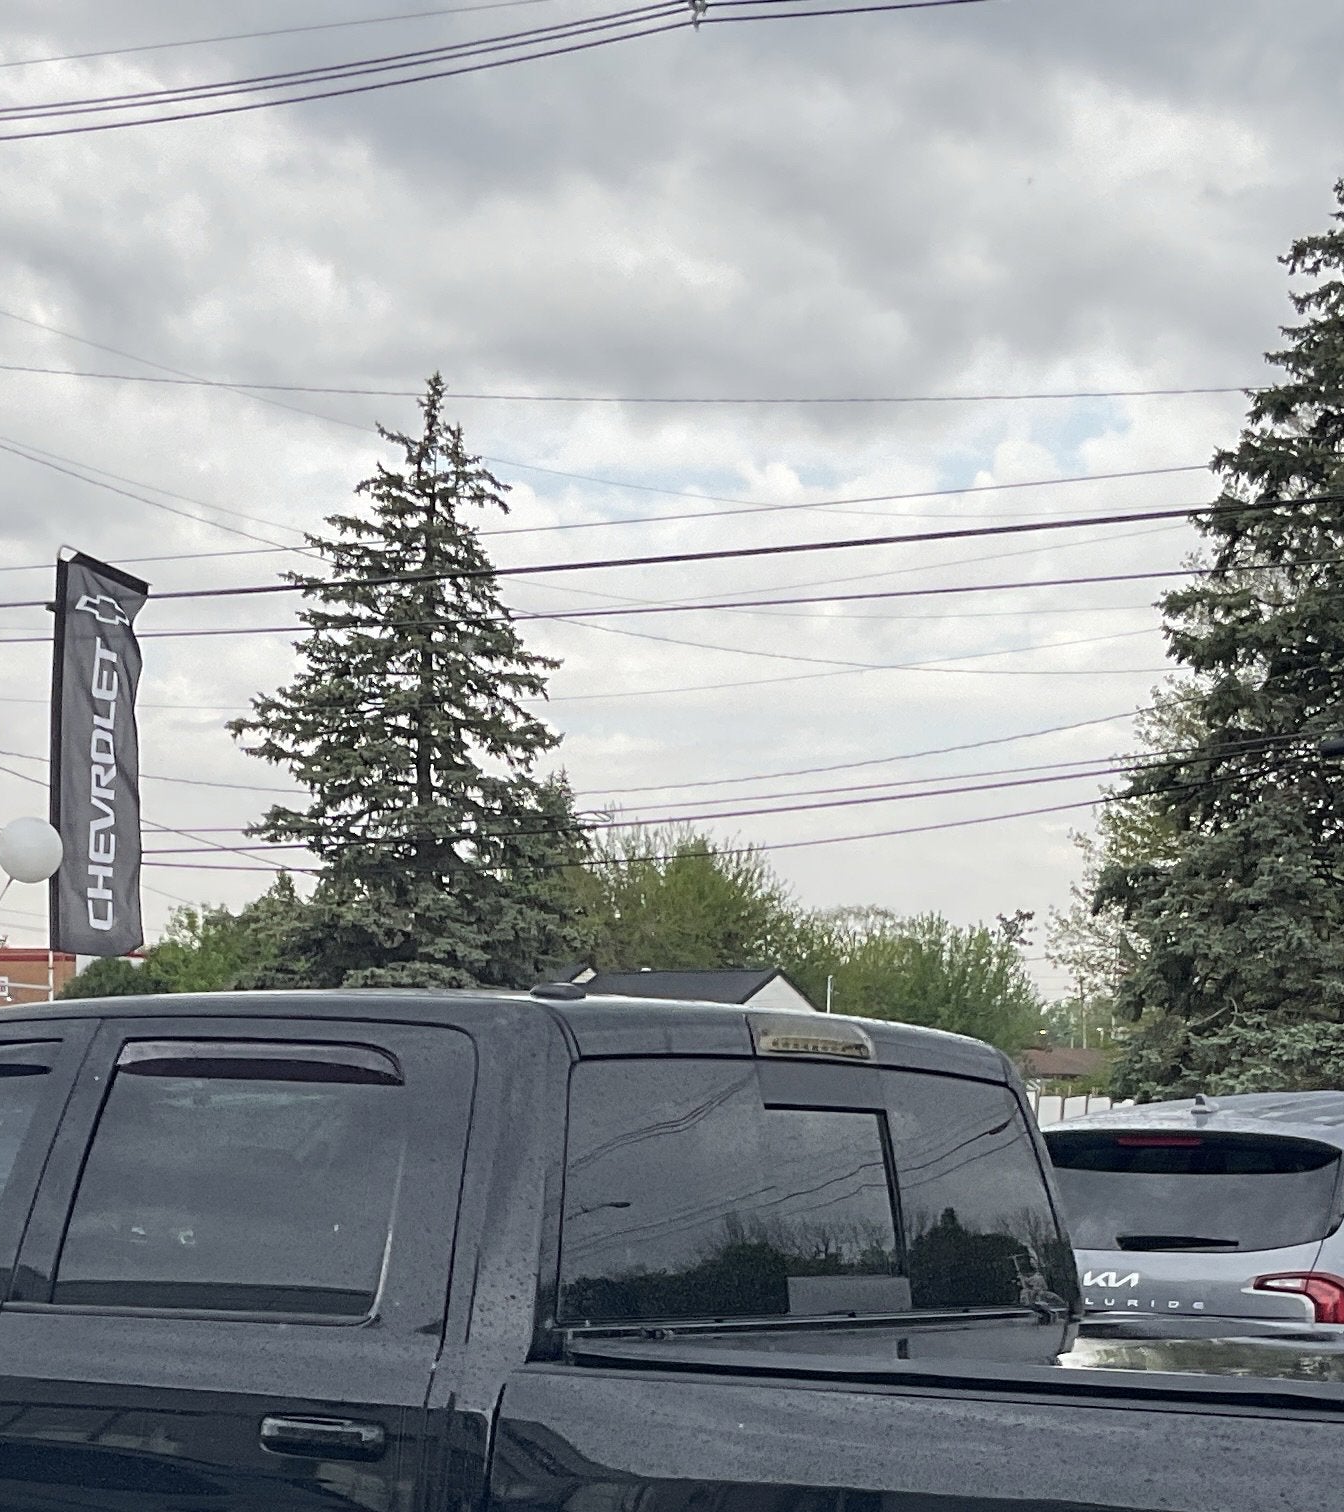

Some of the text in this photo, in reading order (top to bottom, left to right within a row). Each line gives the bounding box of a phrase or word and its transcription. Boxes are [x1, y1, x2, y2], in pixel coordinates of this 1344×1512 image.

[87, 636, 119, 931] CHEVROLET
[1083, 1270, 1139, 1288] KIA
[1084, 1296, 1205, 1311] LURIDE
